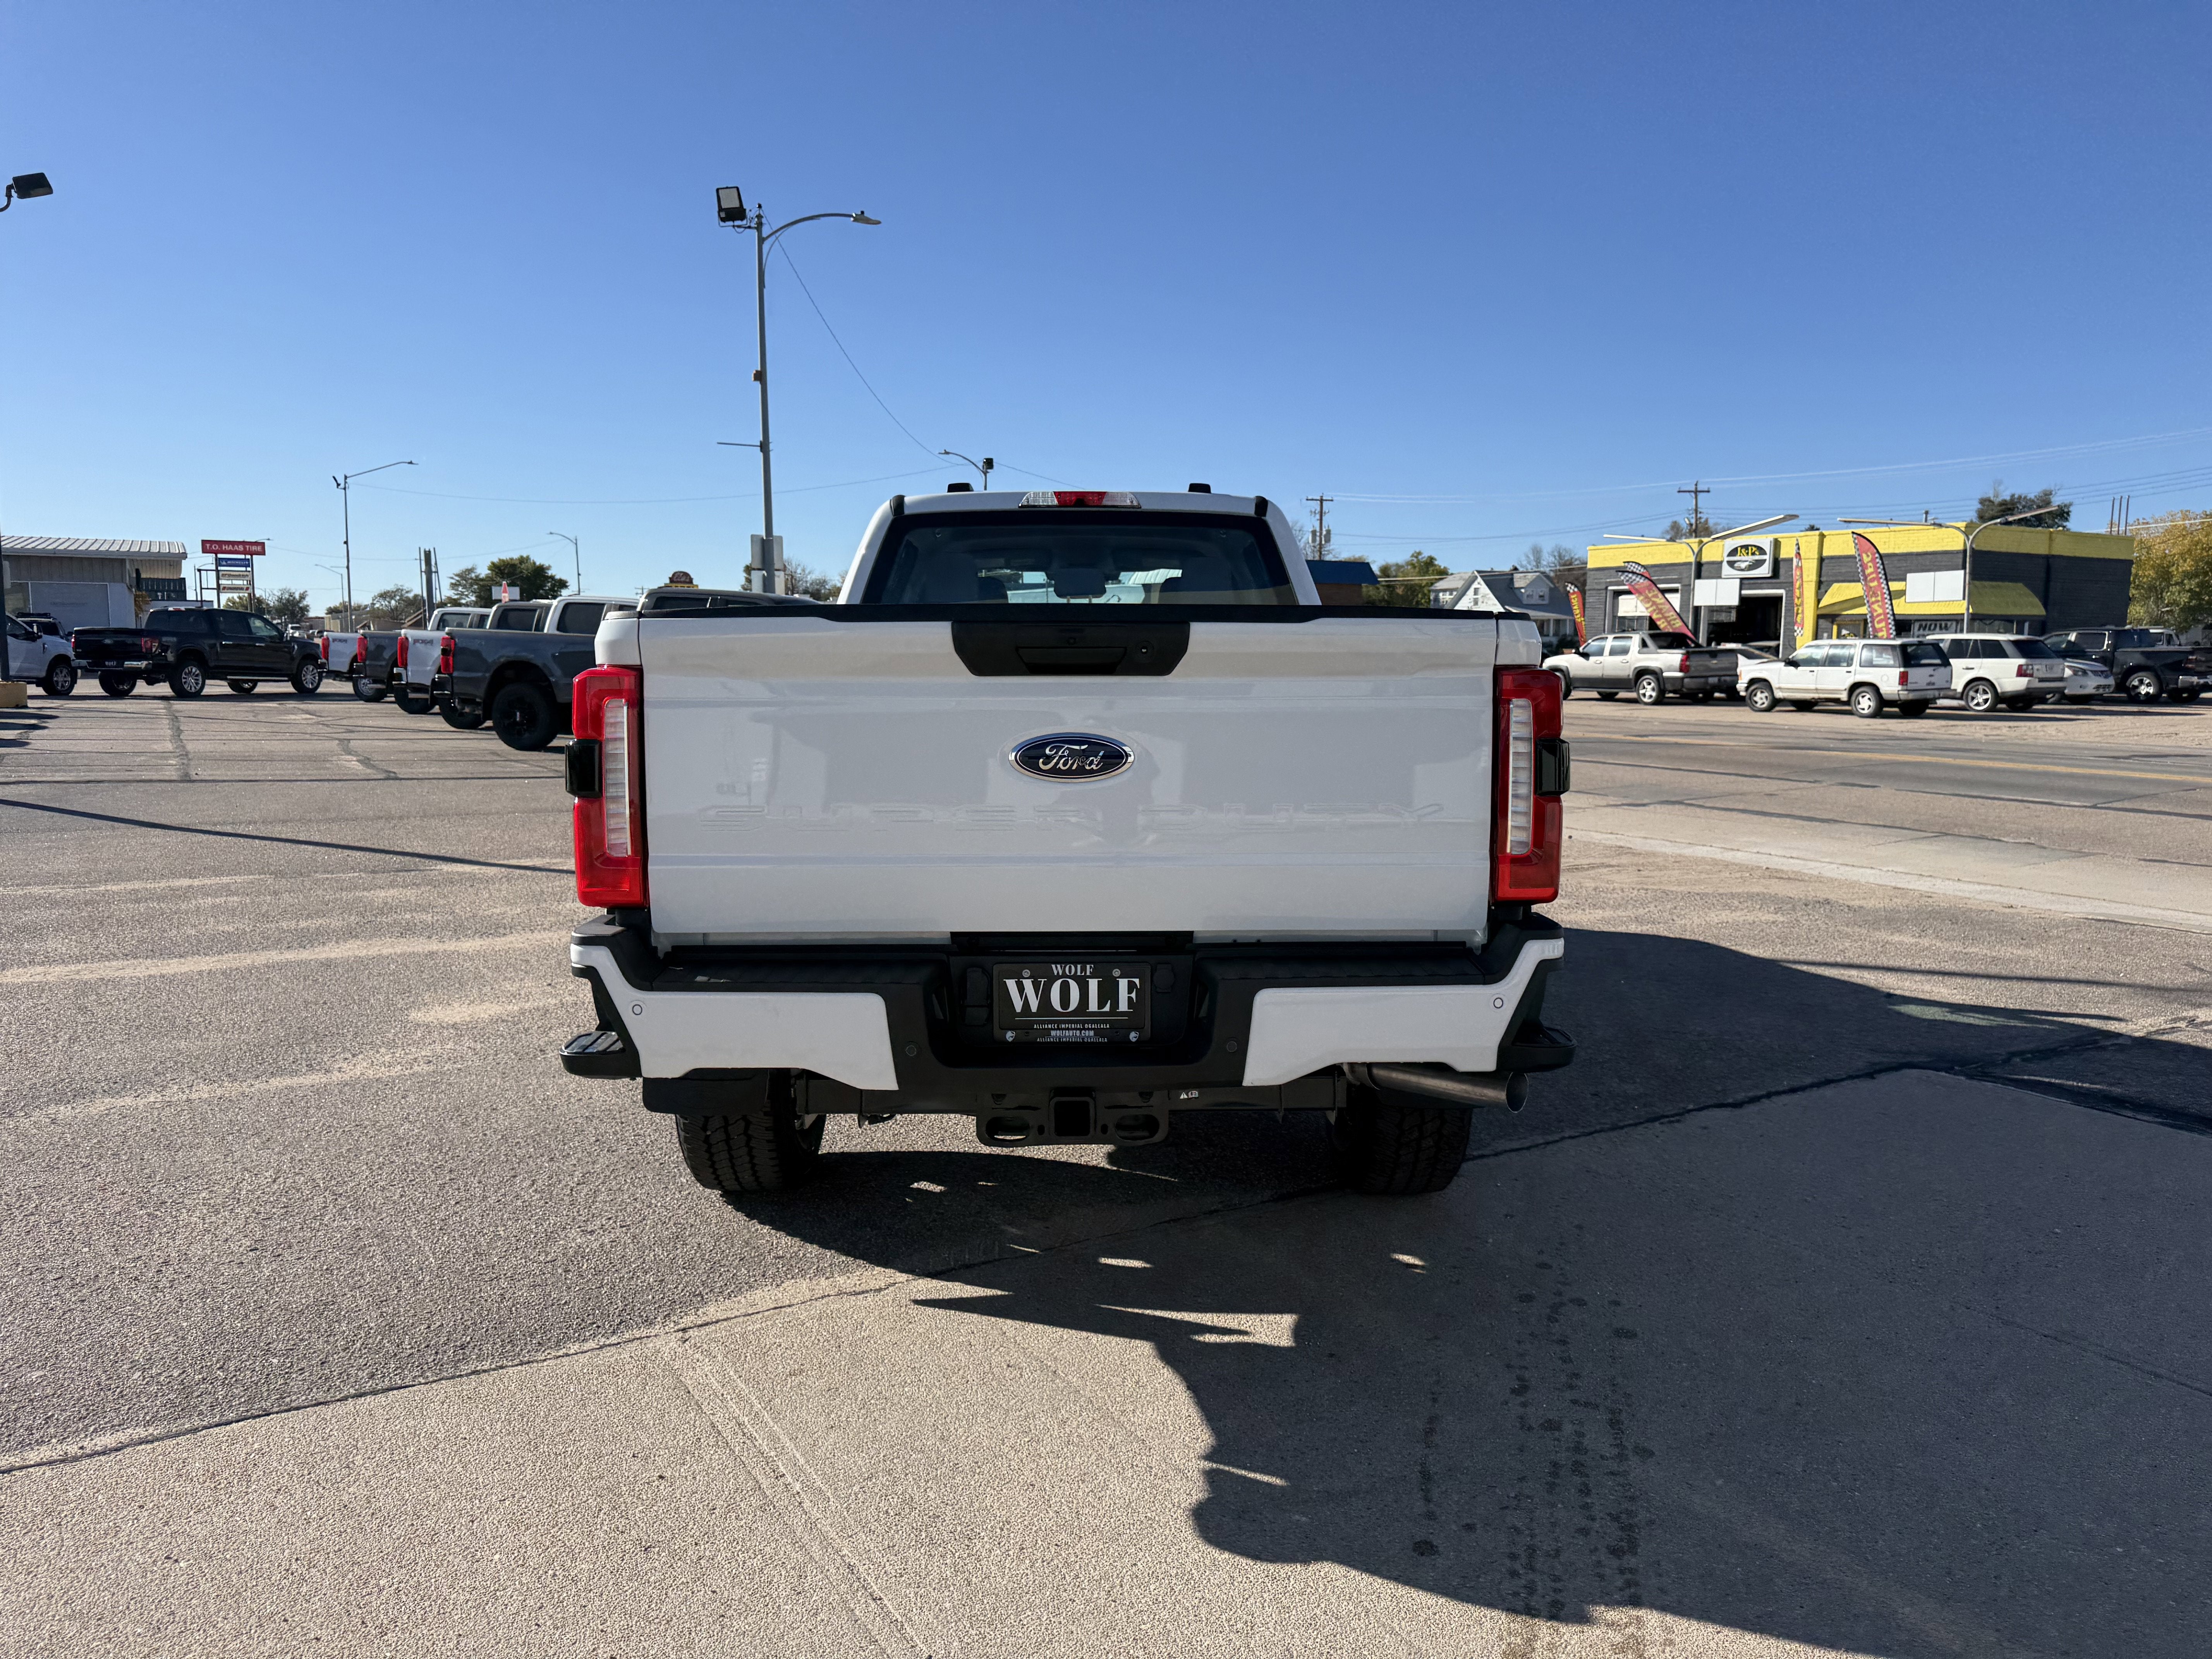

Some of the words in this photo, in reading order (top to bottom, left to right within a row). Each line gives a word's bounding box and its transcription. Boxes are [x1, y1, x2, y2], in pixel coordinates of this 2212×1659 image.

[1917, 622, 1953, 632] NOW
[1039, 744, 1104, 770] Ford
[698, 804, 1104, 833] SUPER
[1136, 802, 1445, 833] DUTY
[1051, 964, 1094, 975] WOLF
[1003, 978, 1140, 1013] WOLF
